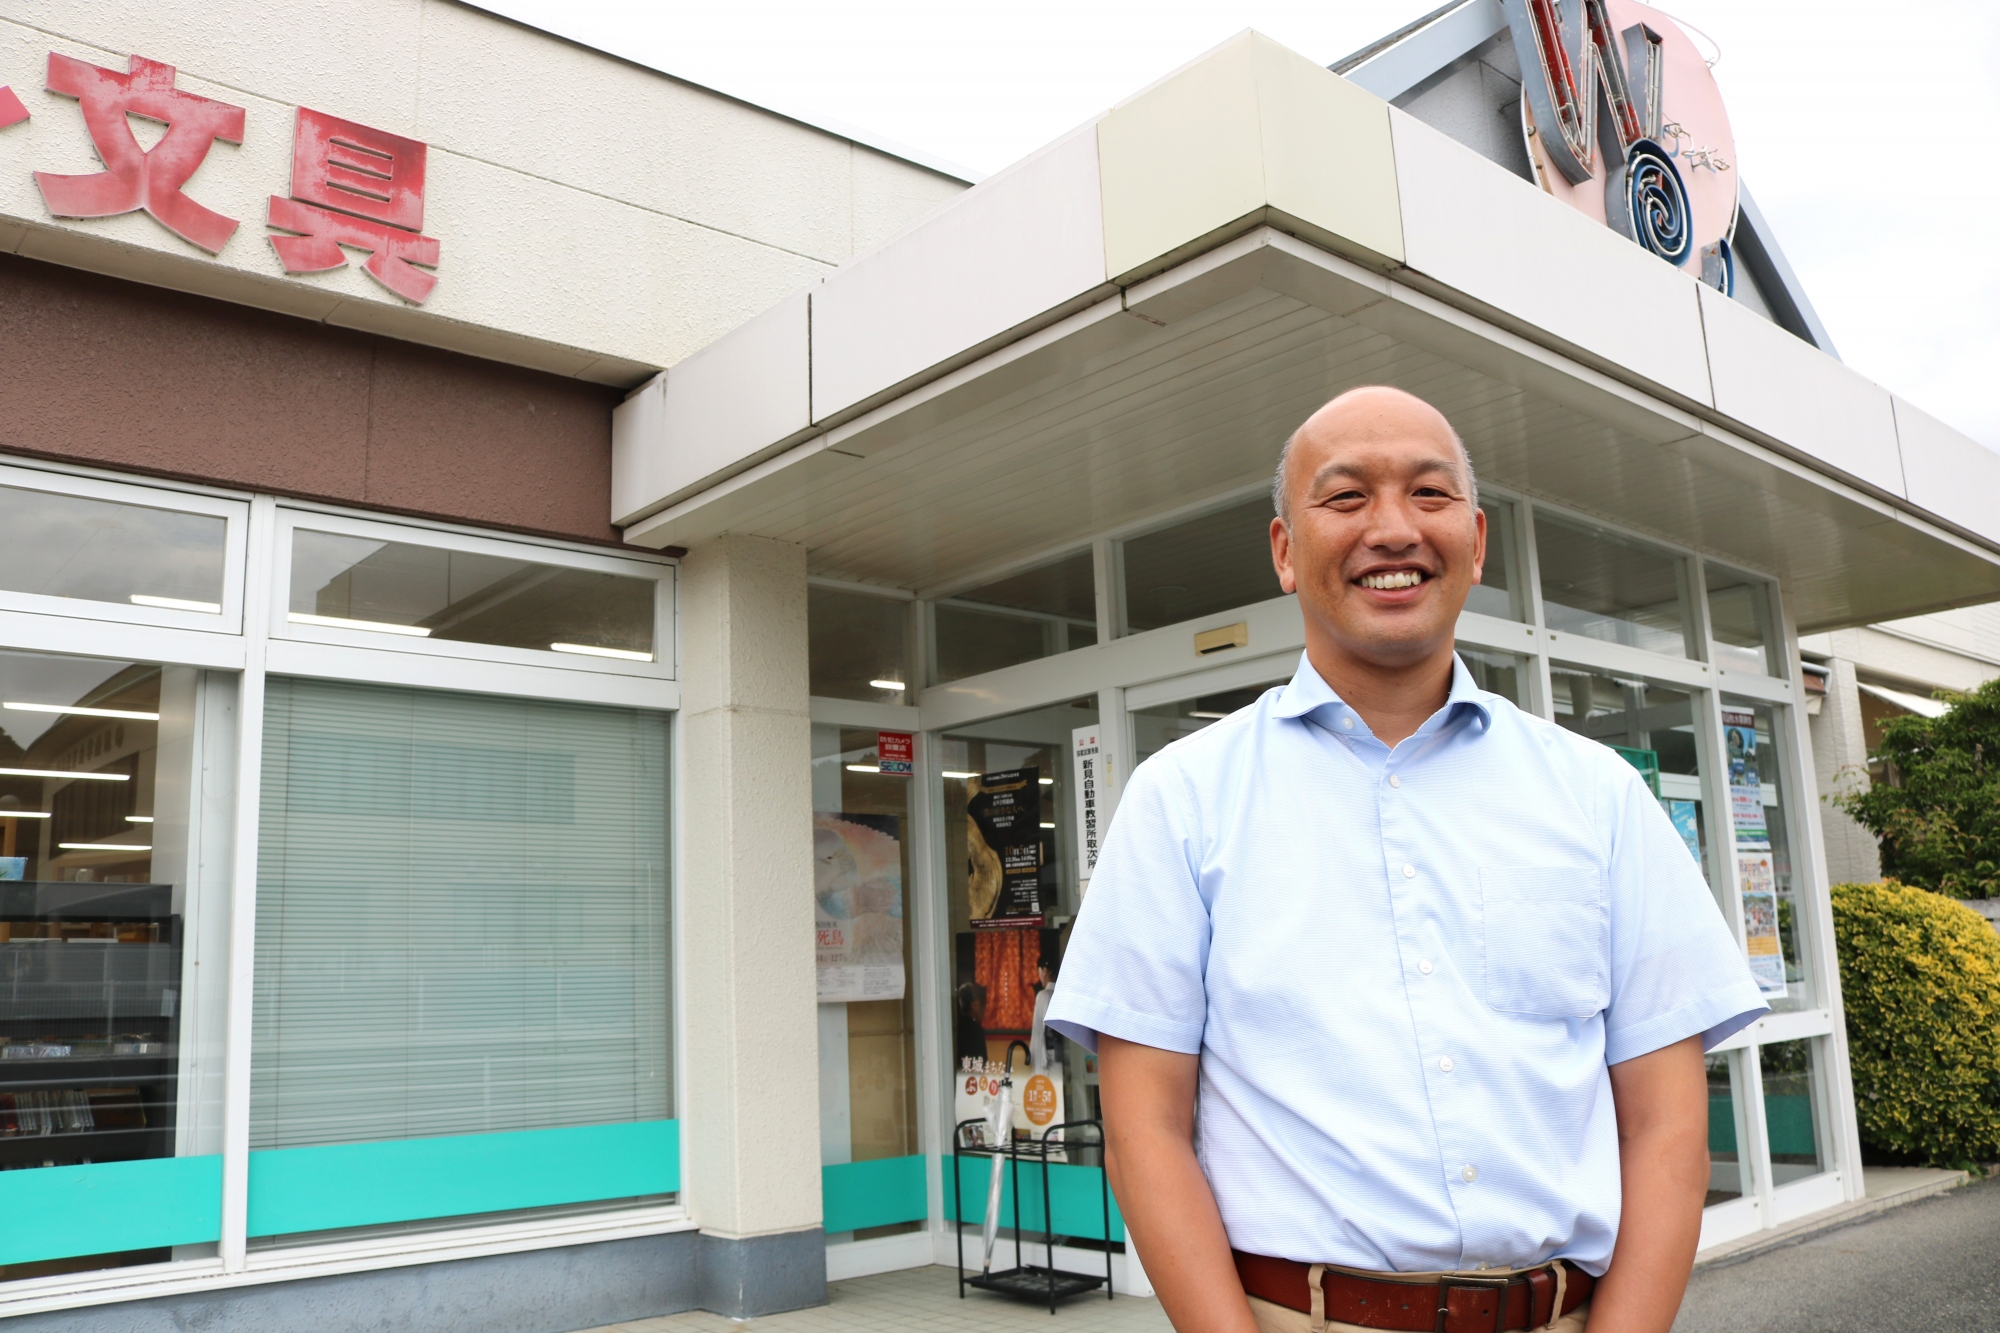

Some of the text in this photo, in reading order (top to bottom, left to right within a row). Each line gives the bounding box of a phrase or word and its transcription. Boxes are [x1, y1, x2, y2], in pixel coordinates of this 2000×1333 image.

[0, 50, 441, 306] 文具
[879, 736, 911, 745] 防犯カメラ
[885, 744, 907, 752] 設置店
[880, 761, 912, 772] SECOM
[1082, 758, 1098, 870] 新見自動車教習所取次所
